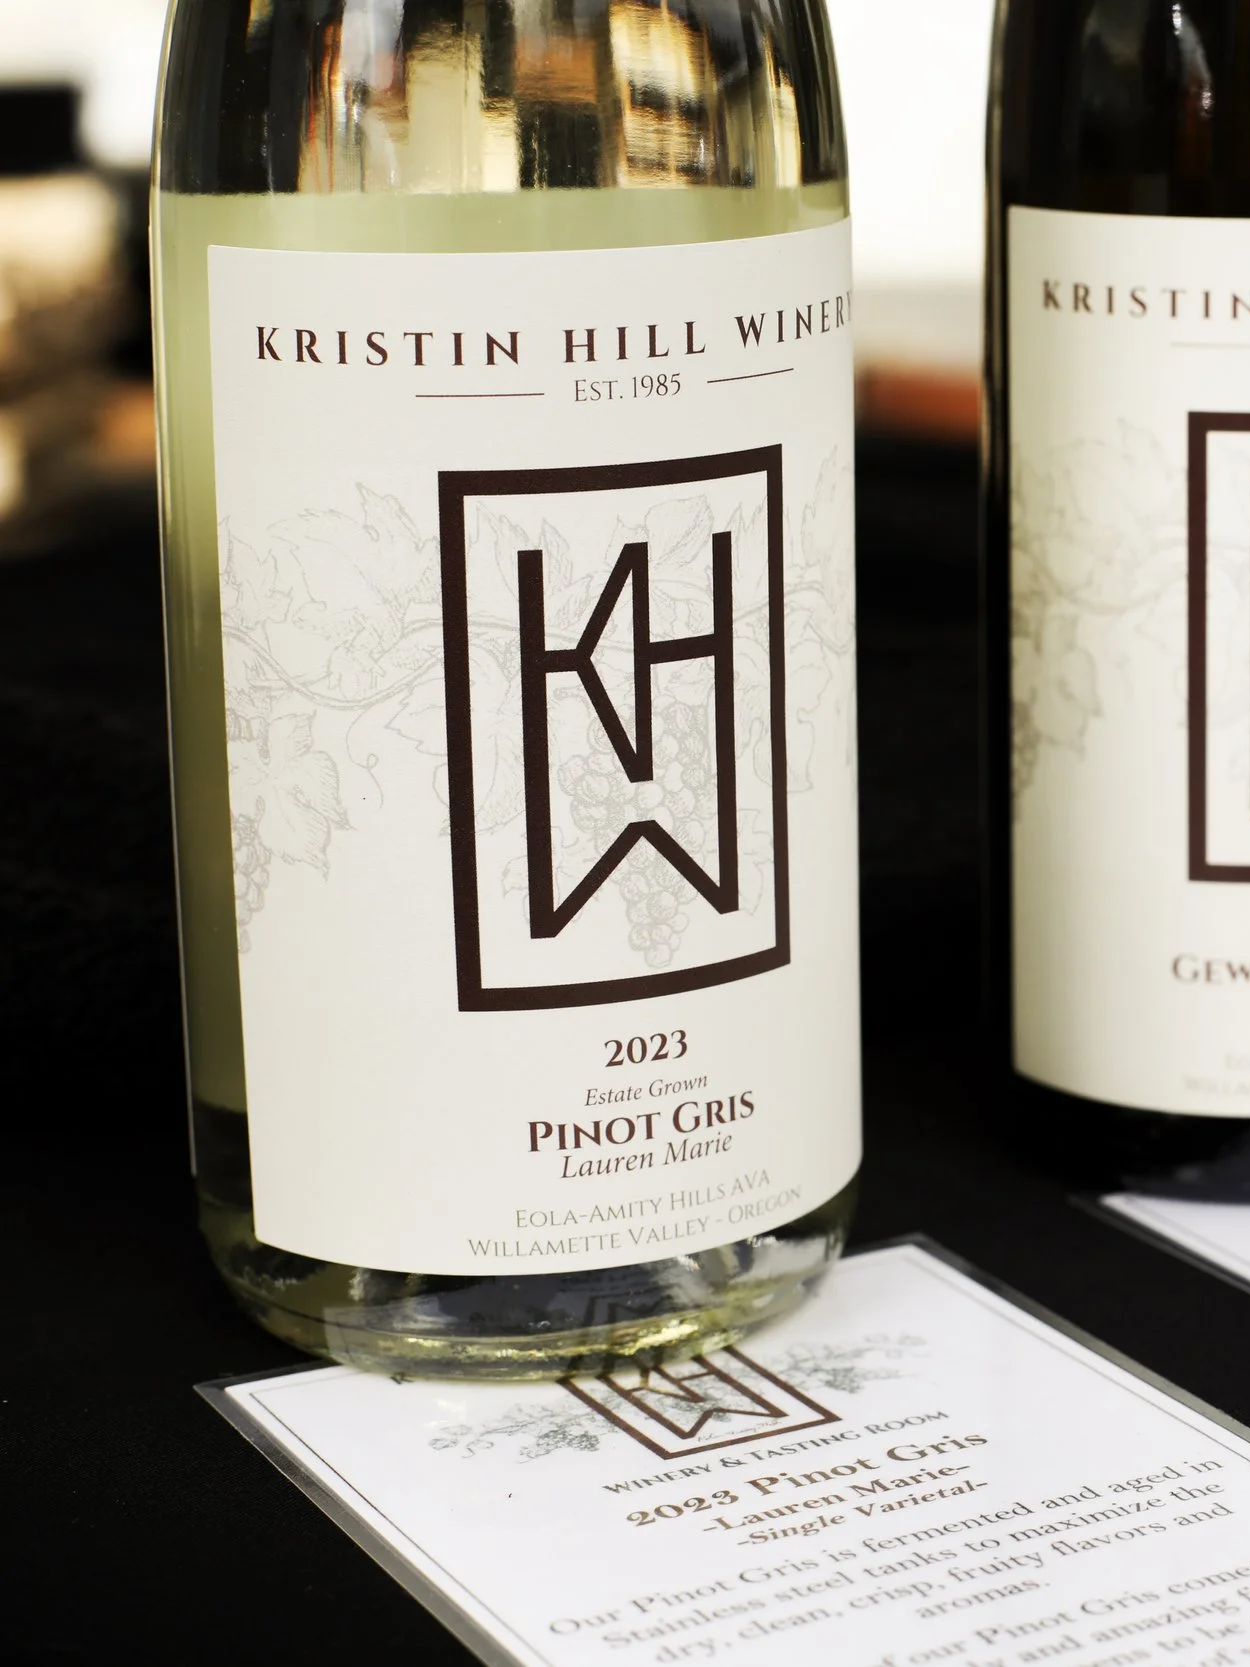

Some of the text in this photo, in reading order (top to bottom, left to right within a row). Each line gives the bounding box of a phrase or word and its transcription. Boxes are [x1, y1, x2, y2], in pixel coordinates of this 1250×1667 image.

[256, 326, 520, 367] KRISTIN
[563, 320, 707, 364] HILL
[574, 373, 682, 402] EST. 1985
[604, 1029, 688, 1067] 2023
[584, 1073, 709, 1107] Estate Grown
[560, 1131, 733, 1179] Lauren Marie
[731, 1169, 771, 1197] AVA
[602, 1462, 712, 1495] WINERY
[720, 1456, 744, 1469] &
[748, 1430, 861, 1461] TASTING
[865, 1410, 950, 1437] ROOM
[627, 1432, 989, 1527] 2023 Pinot Gris
[702, 1463, 970, 1533] -Lauren Marie-
[737, 1481, 989, 1547] -Single Varietal-
[549, 1458, 1224, 1636] Our Pinot Gris is fermented and aged in
[602, 1481, 1226, 1649] Stainless steel tanks to maximize the
[655, 1501, 1236, 1664] dry, clean, crisp, fruity flavors and
[916, 1577, 1052, 1619] aromas.
[906, 1640, 968, 1666] our
[974, 1611, 1077, 1645] Pinot
[1081, 1589, 1160, 1617] Gris
[1016, 1634, 1083, 1664] and
[1090, 1598, 1240, 1645] amazing
[1157, 1635, 1196, 1653] to
[1196, 1621, 1246, 1641] be
